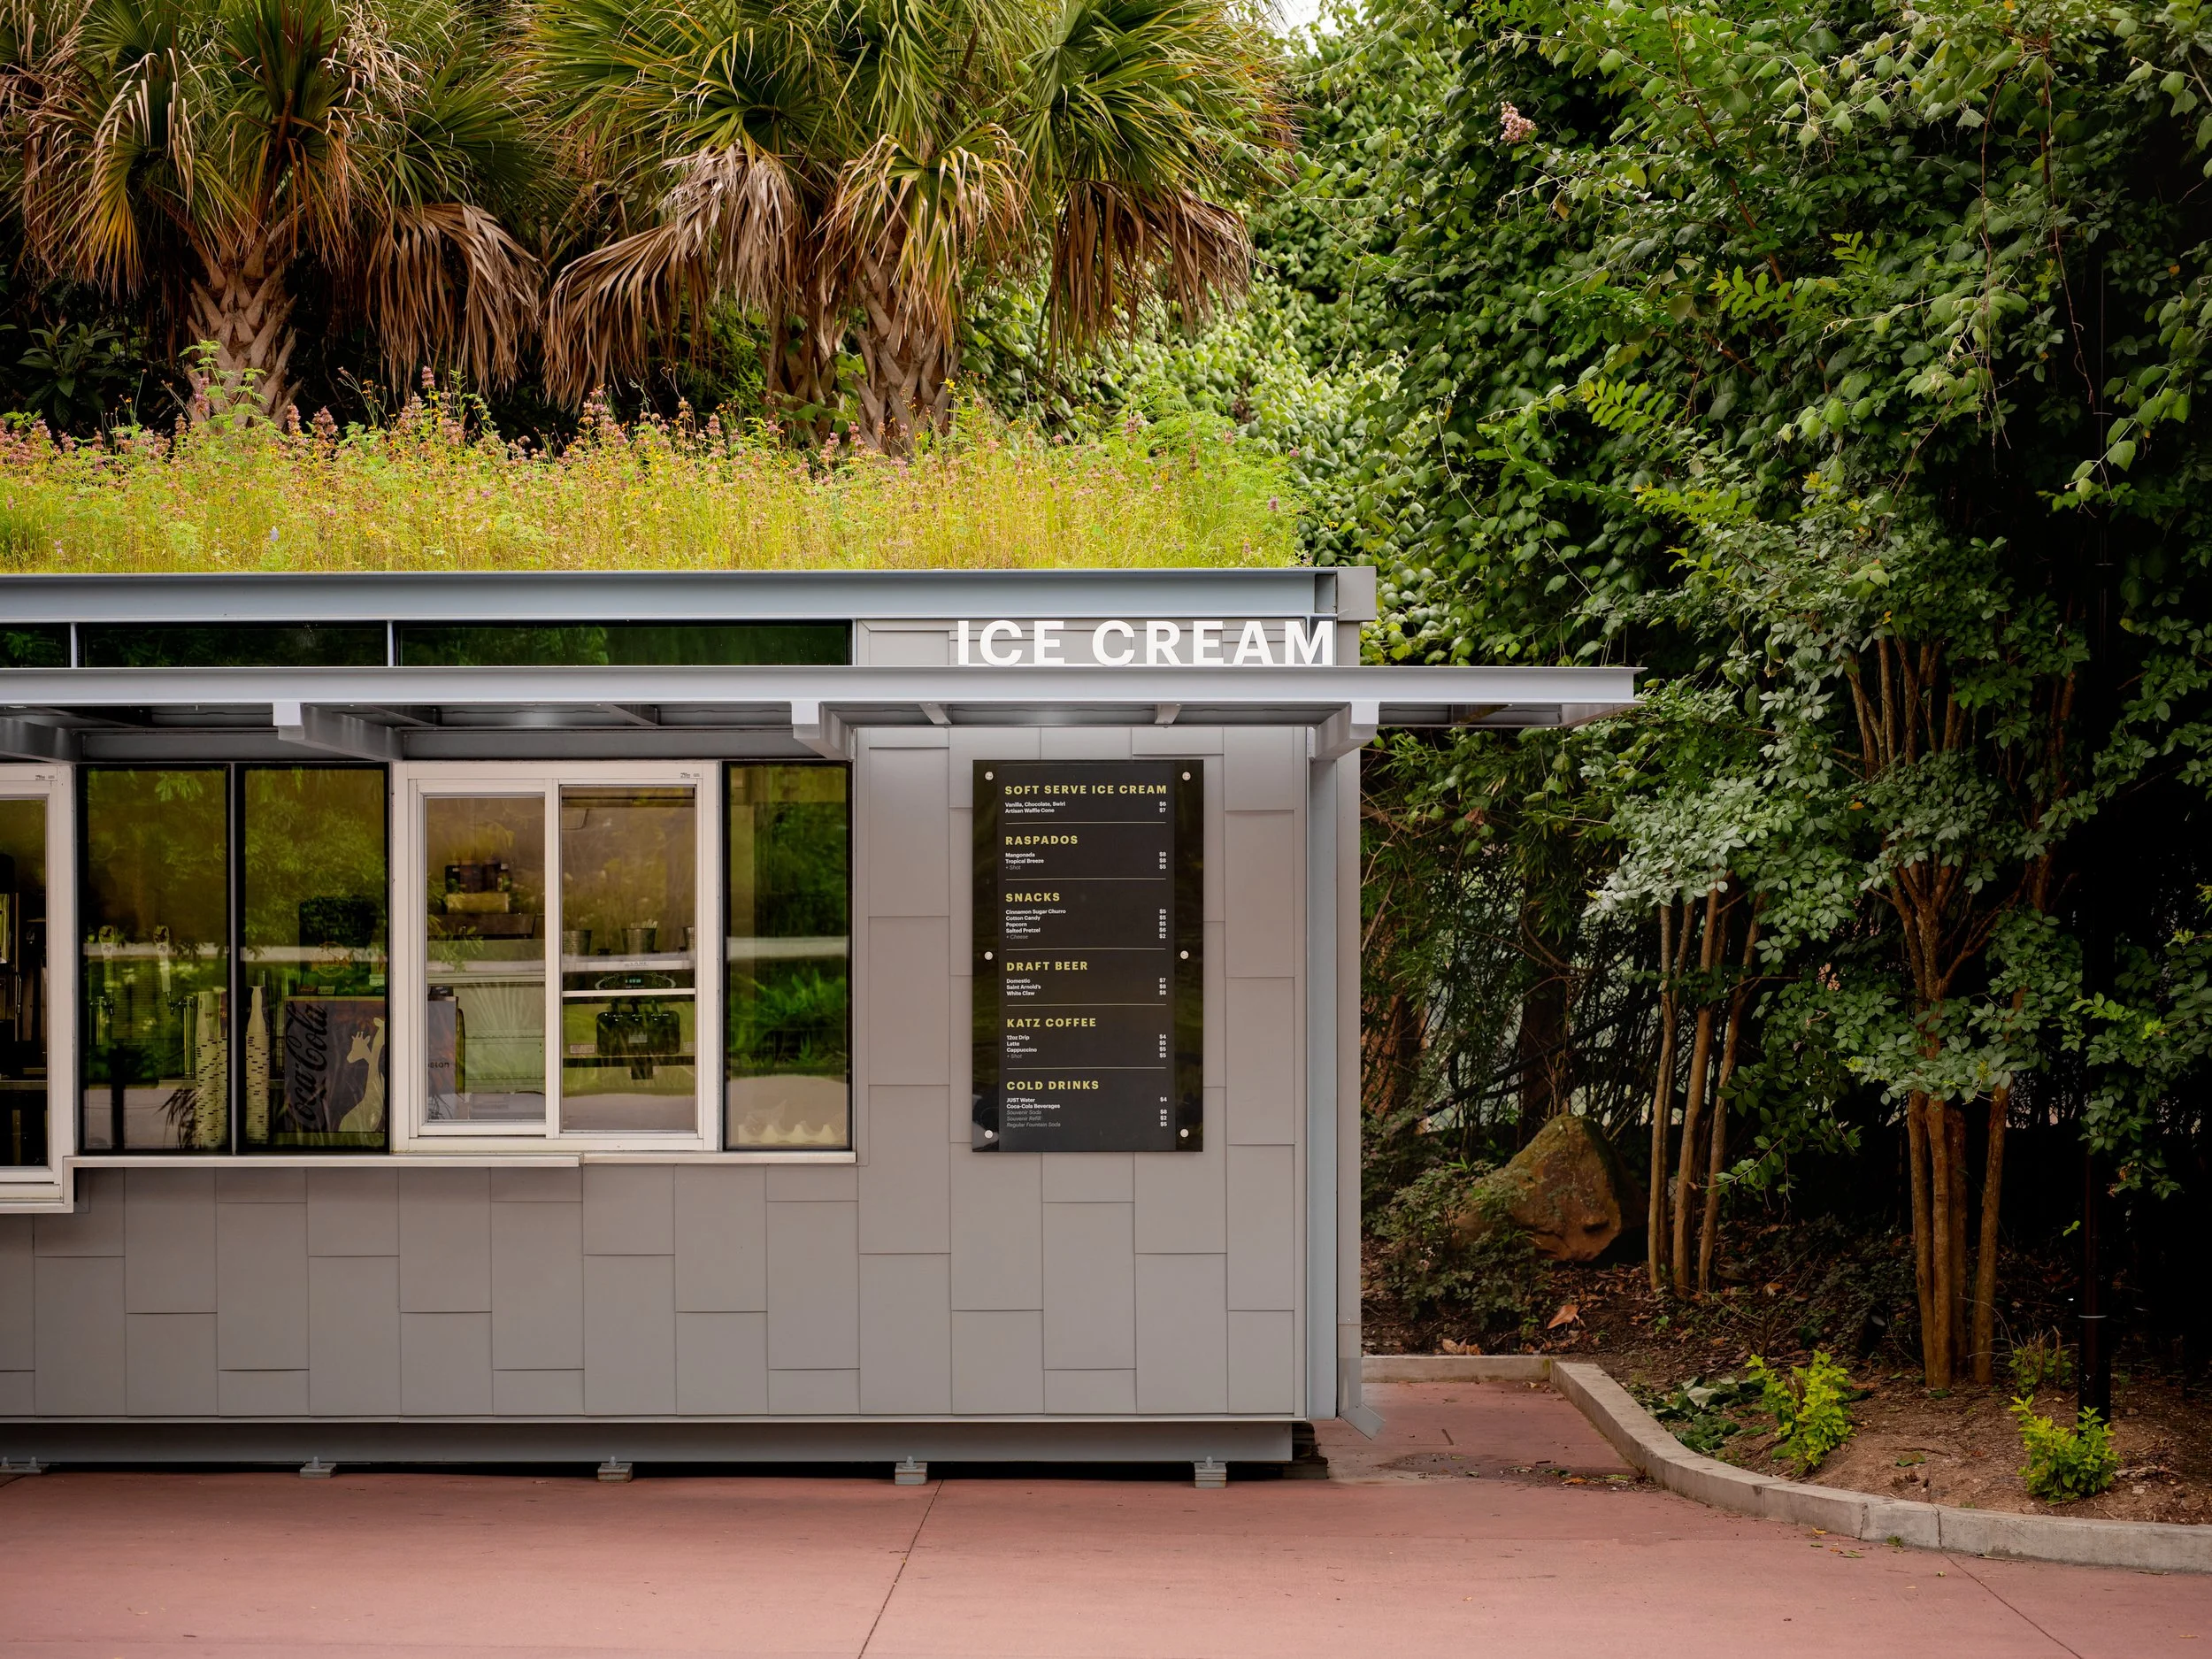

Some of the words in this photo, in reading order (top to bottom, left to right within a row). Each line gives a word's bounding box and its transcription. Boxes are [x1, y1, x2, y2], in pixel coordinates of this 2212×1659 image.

[957, 620, 1065, 665] ICE
[1092, 620, 1333, 665] CREAM
[1005, 786, 1039, 795] SOFT
[1006, 835, 1078, 845] RASPADOS
[1006, 893, 1059, 902] SNACKS
[1007, 962, 1049, 971] DRAFT
[1007, 1018, 1040, 1027] KATZ
[1046, 1018, 1095, 1027] COFFEE
[1007, 1081, 1042, 1090] COLD
